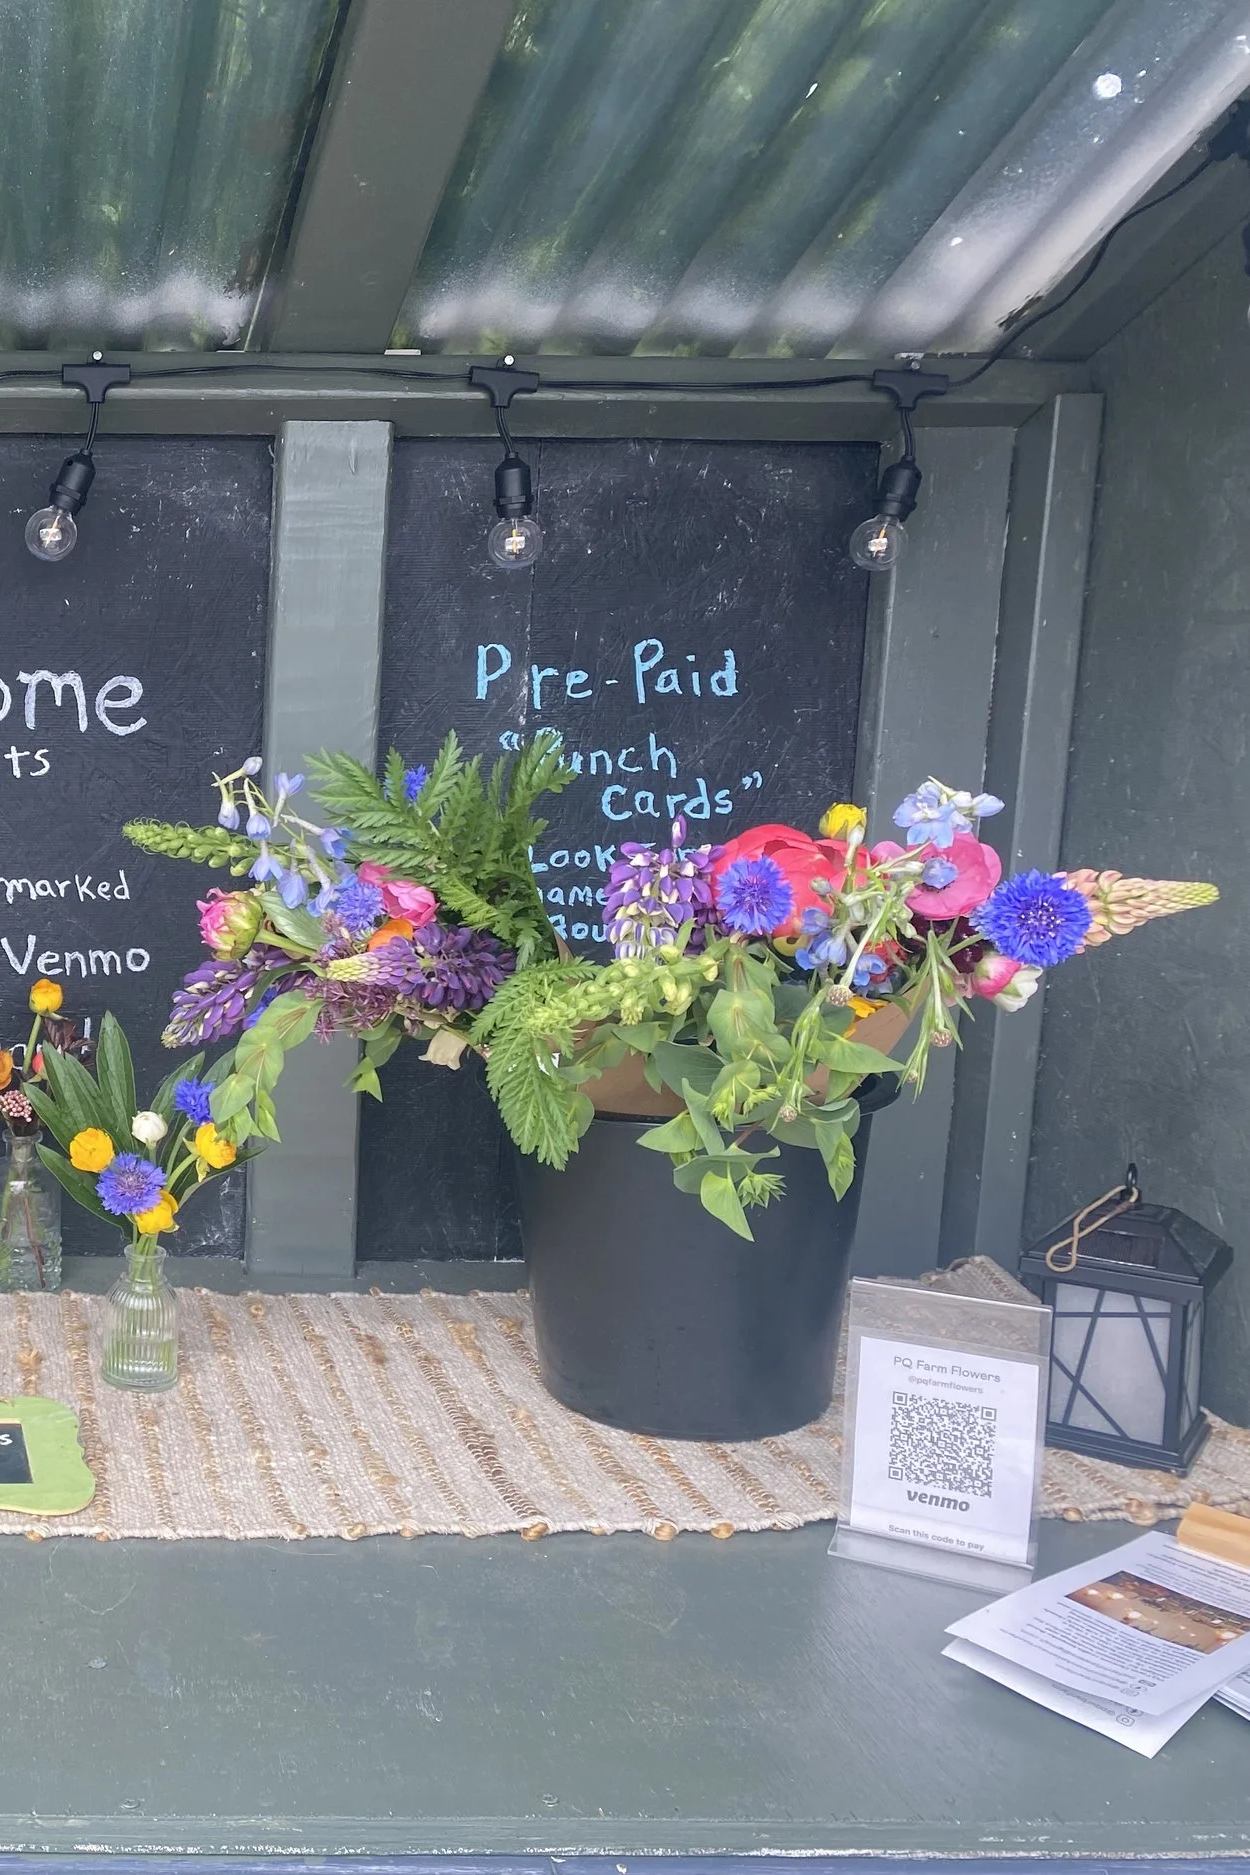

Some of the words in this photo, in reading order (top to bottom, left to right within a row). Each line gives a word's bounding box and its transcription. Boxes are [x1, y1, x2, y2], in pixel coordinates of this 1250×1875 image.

[476, 638, 739, 711] Pre-Paid
[0, 934, 152, 979] Venmo
[893, 1356, 913, 1370] PQ
[916, 1360, 948, 1374] Farm
[951, 1365, 1001, 1383] Flowers
[906, 1489, 971, 1512] venmo
[888, 1524, 911, 1536] Scan
[912, 1529, 930, 1540] this
[931, 1534, 955, 1545] code
[956, 1538, 966, 1547] to
[967, 1541, 985, 1552] pay
